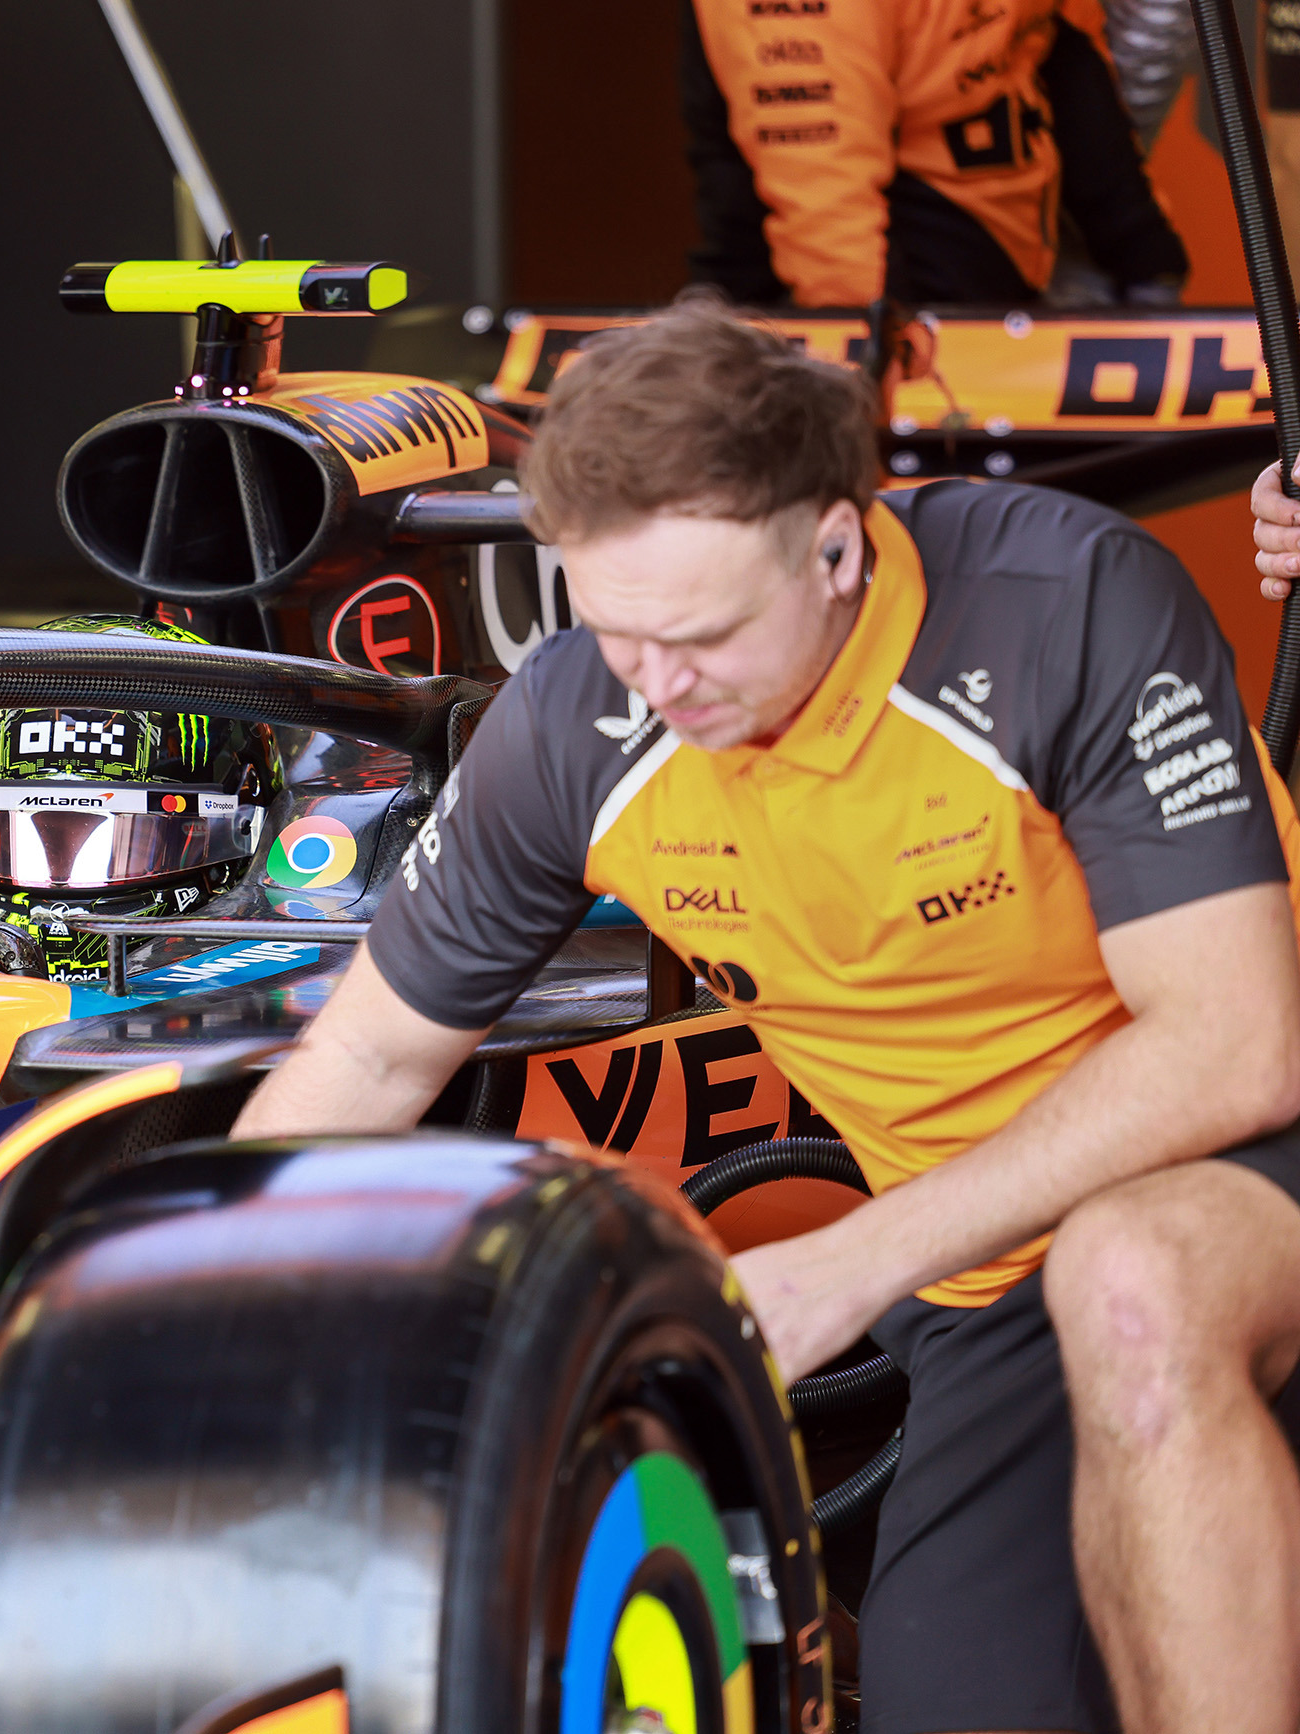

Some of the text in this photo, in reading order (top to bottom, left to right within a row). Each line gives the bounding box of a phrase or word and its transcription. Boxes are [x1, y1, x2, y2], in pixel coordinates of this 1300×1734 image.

[297, 385, 479, 469] allwyn
[18, 796, 103, 807] McLaren
[212, 801, 235, 810] Dropbox
[664, 886, 747, 915] DELL
